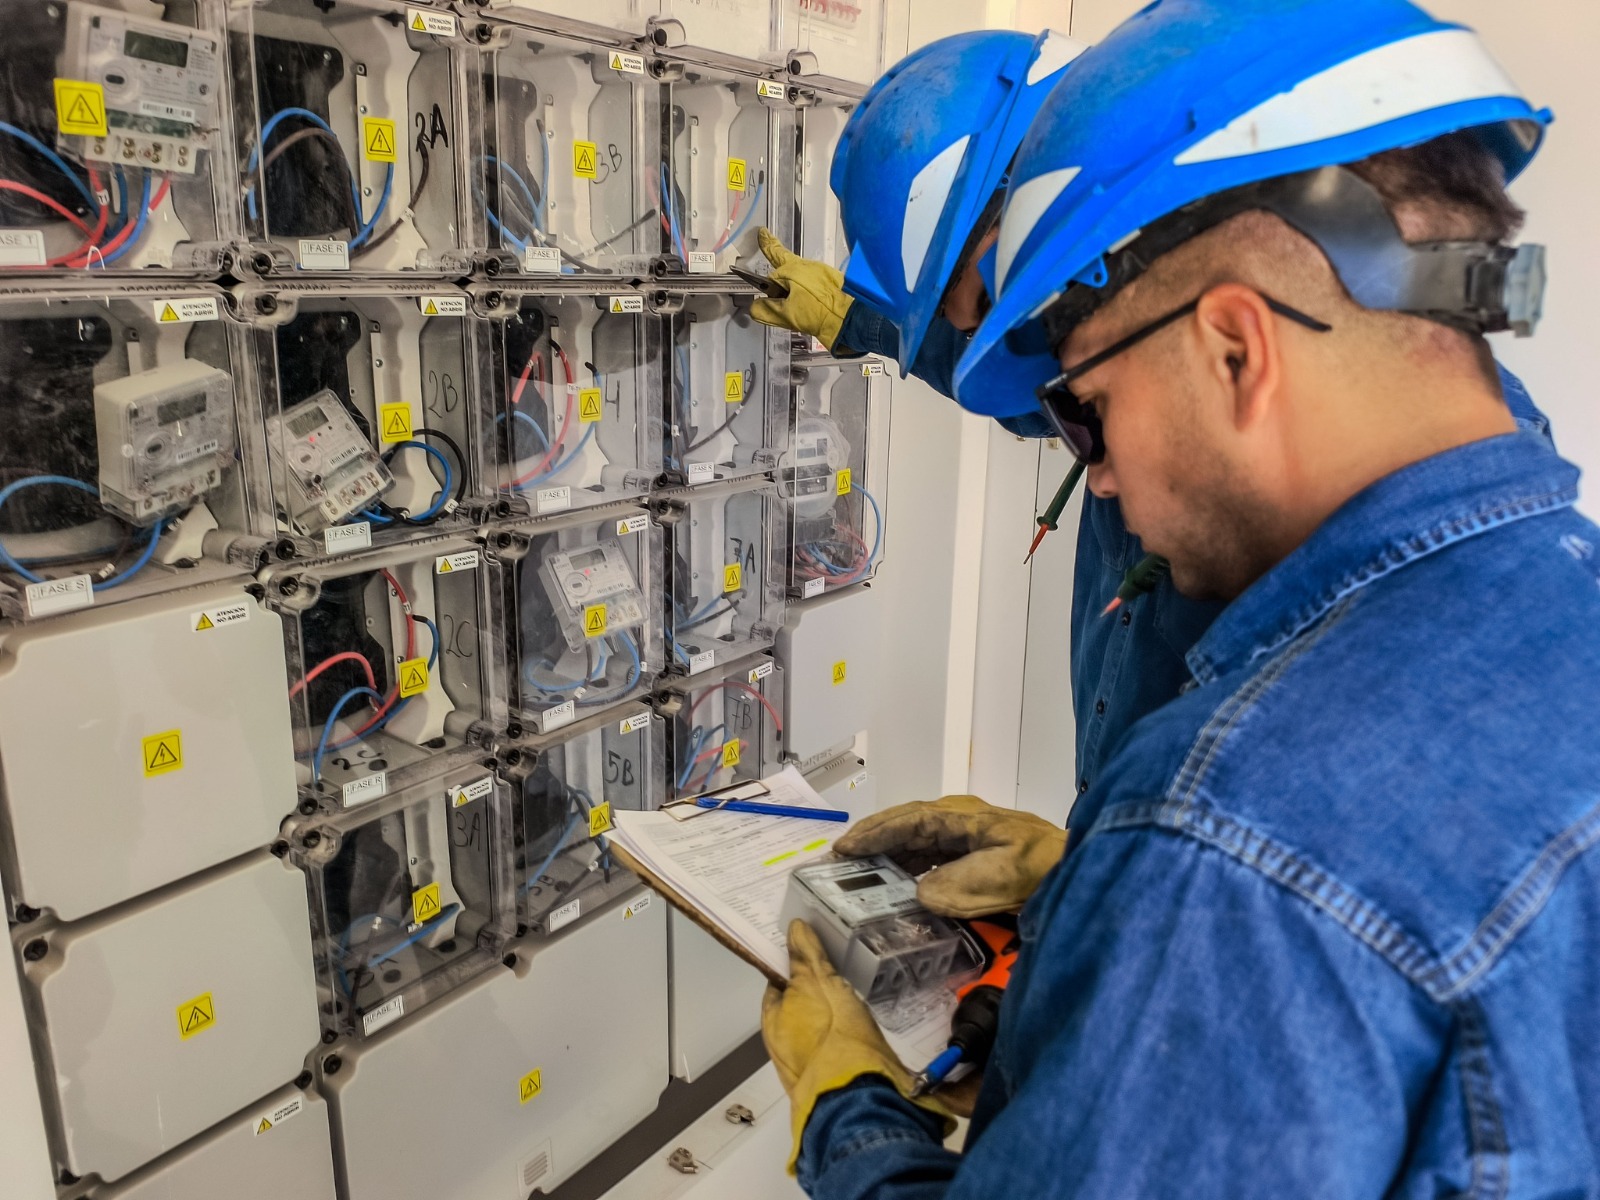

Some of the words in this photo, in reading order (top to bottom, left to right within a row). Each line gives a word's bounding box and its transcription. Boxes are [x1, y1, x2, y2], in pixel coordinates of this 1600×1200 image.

[0, 234, 22, 246] ASE
[309, 244, 332, 253] FASE
[336, 245, 344, 253] R
[533, 250, 550, 258] FASE
[181, 302, 214, 310] ATENCIÓN
[428, 370, 458, 418] 2B
[334, 527, 356, 537] FASE
[359, 525, 366, 534] S
[730, 537, 756, 574] 7A
[40, 583, 74, 596] FASE
[76, 579, 85, 589] S
[227, 612, 246, 621] ABRIR
[443, 614, 473, 658] 2C
[728, 696, 752, 734] 7B
[604, 749, 635, 787] 5B
[351, 781, 372, 793] FASE
[453, 811, 480, 852] 3A
[370, 1007, 390, 1023] FASE
